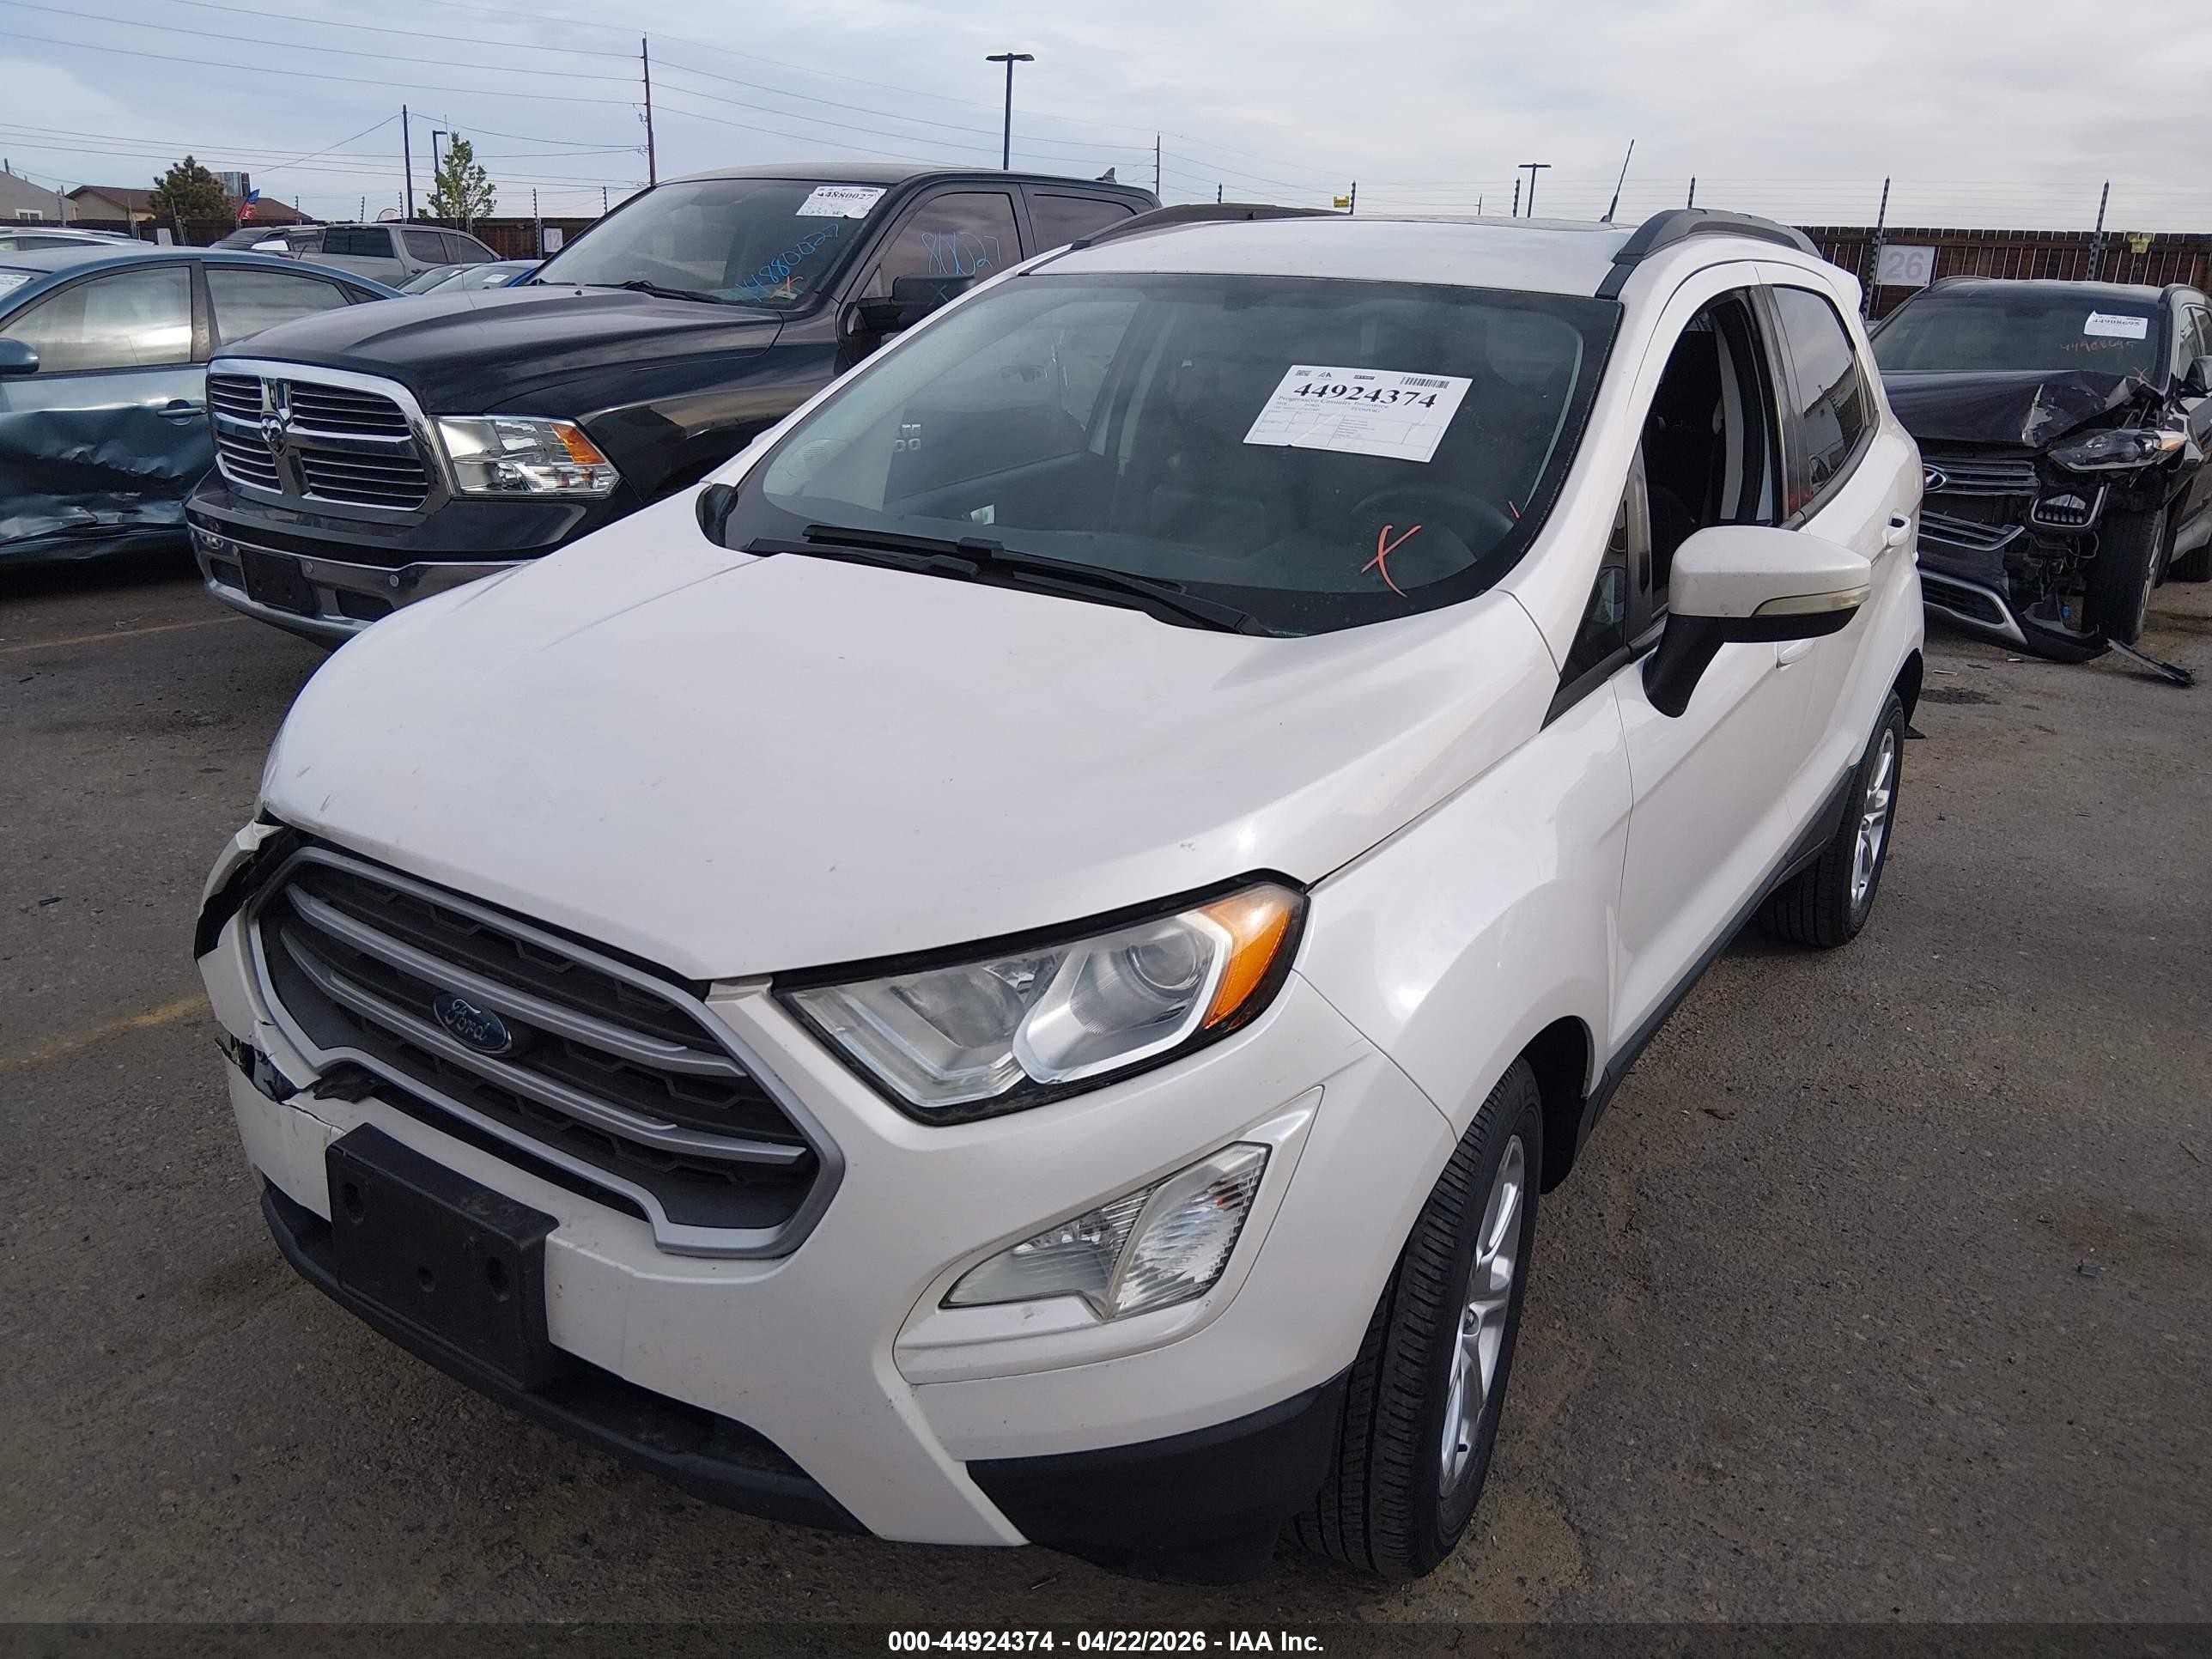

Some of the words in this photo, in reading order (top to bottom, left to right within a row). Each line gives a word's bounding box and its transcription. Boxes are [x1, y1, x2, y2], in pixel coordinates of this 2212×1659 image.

[1885, 252, 1923, 279] 26
[1292, 382, 1438, 409] 44924374
[445, 998, 491, 1041] Ford
